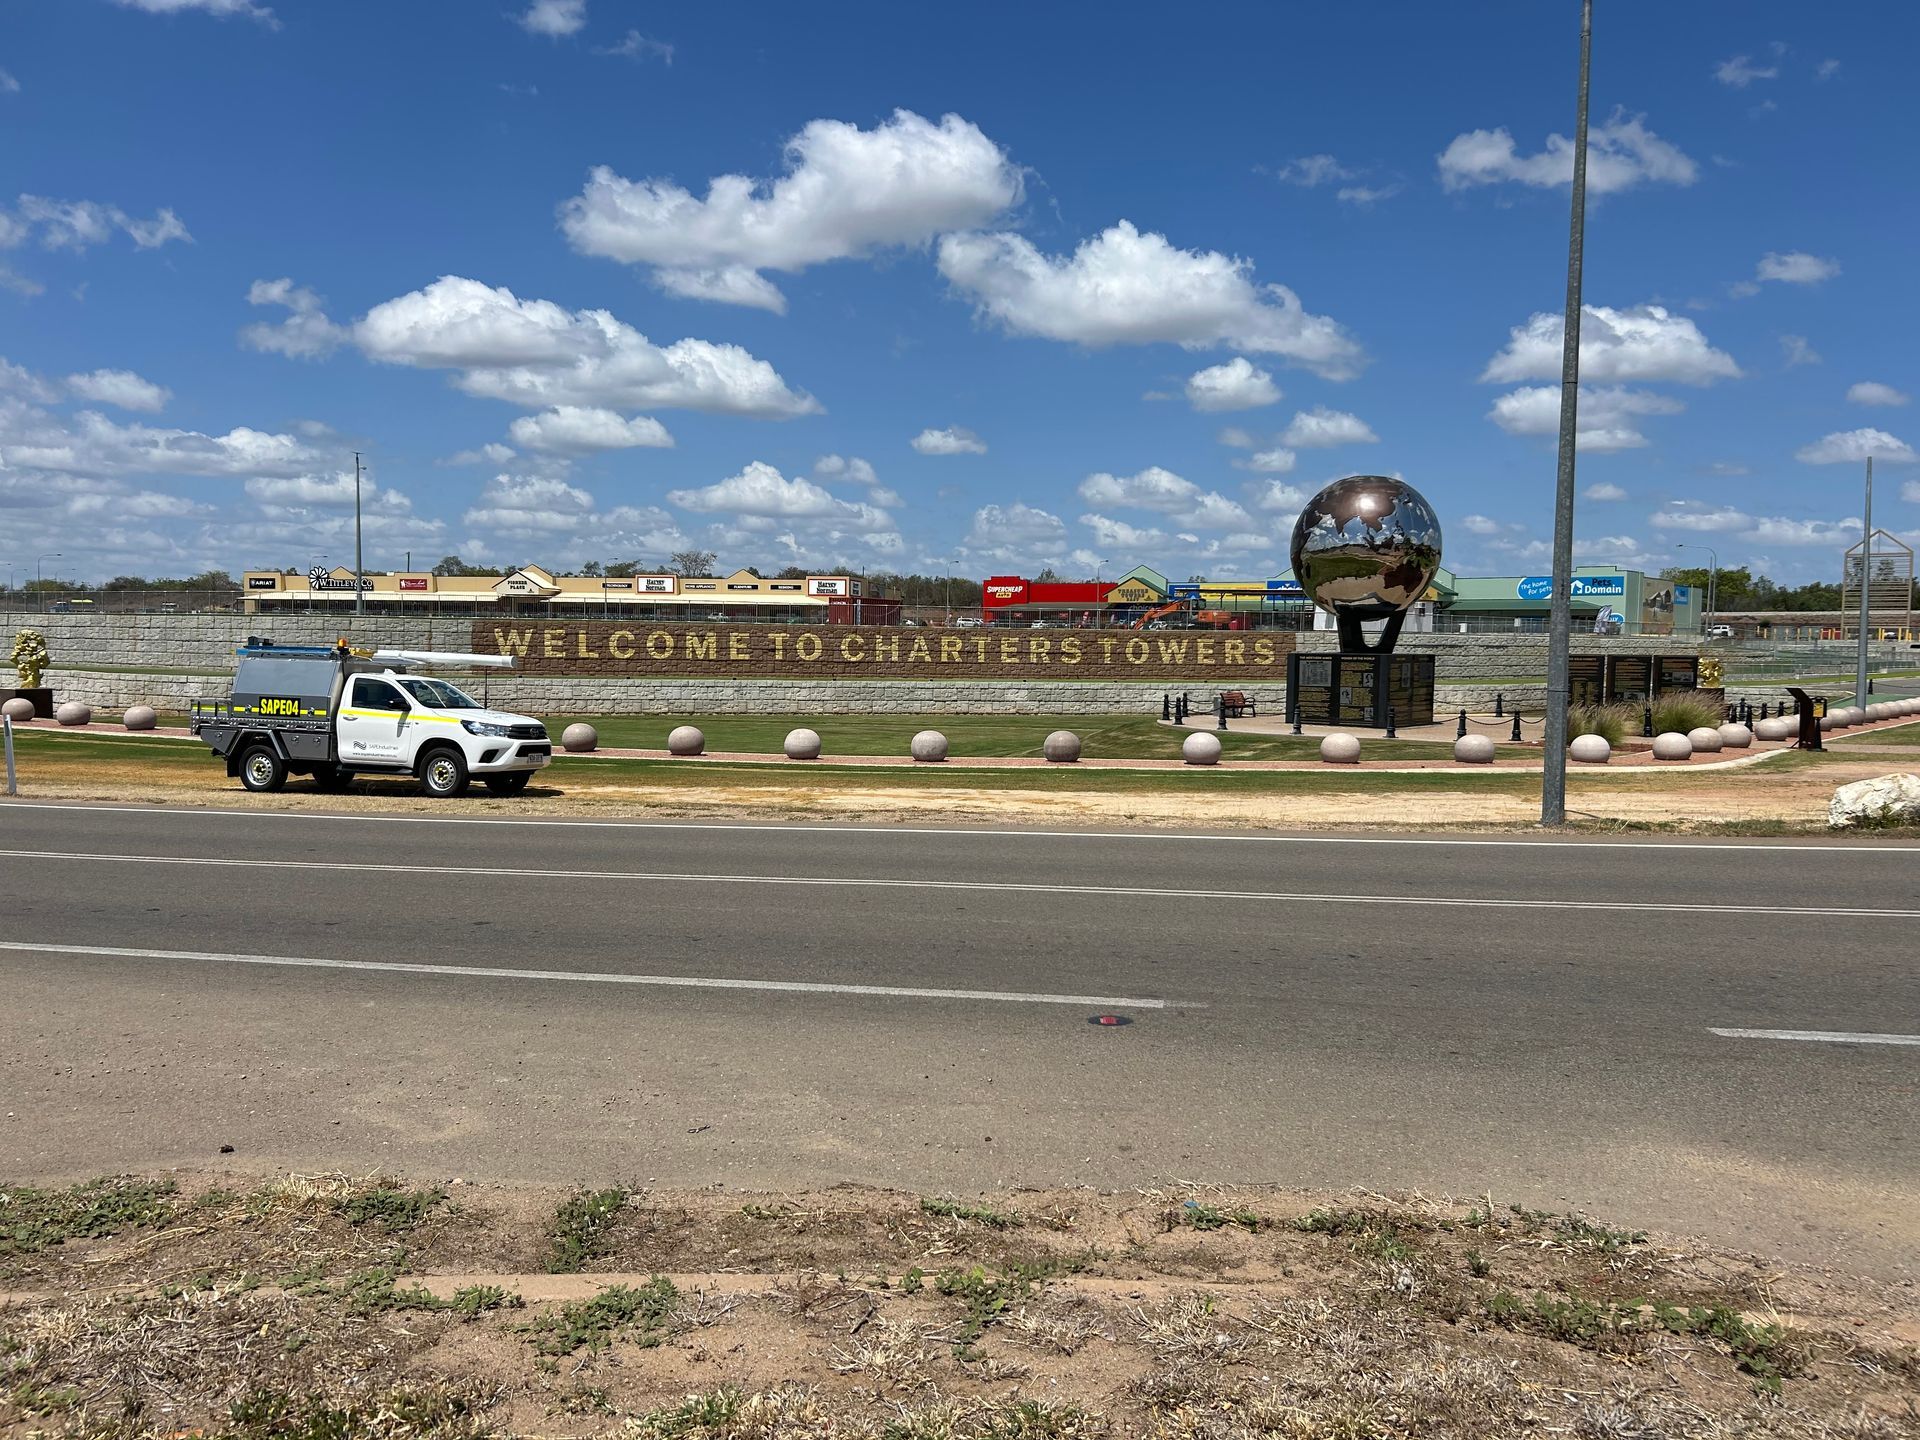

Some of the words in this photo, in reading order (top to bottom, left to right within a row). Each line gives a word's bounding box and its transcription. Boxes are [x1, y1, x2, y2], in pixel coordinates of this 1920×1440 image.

[1532, 580, 1548, 588] home
[1591, 578, 1612, 587] Pets
[816, 587, 838, 595] Norman
[987, 585, 1023, 594] SUPERCHEAP
[1527, 587, 1538, 596] for
[1584, 584, 1622, 594] Domain
[494, 629, 751, 660] WELCOME
[767, 632, 823, 662] TO
[840, 634, 1082, 665] CHARTERS
[1097, 637, 1276, 666] TOWERS
[260, 698, 299, 716] SAPE04
